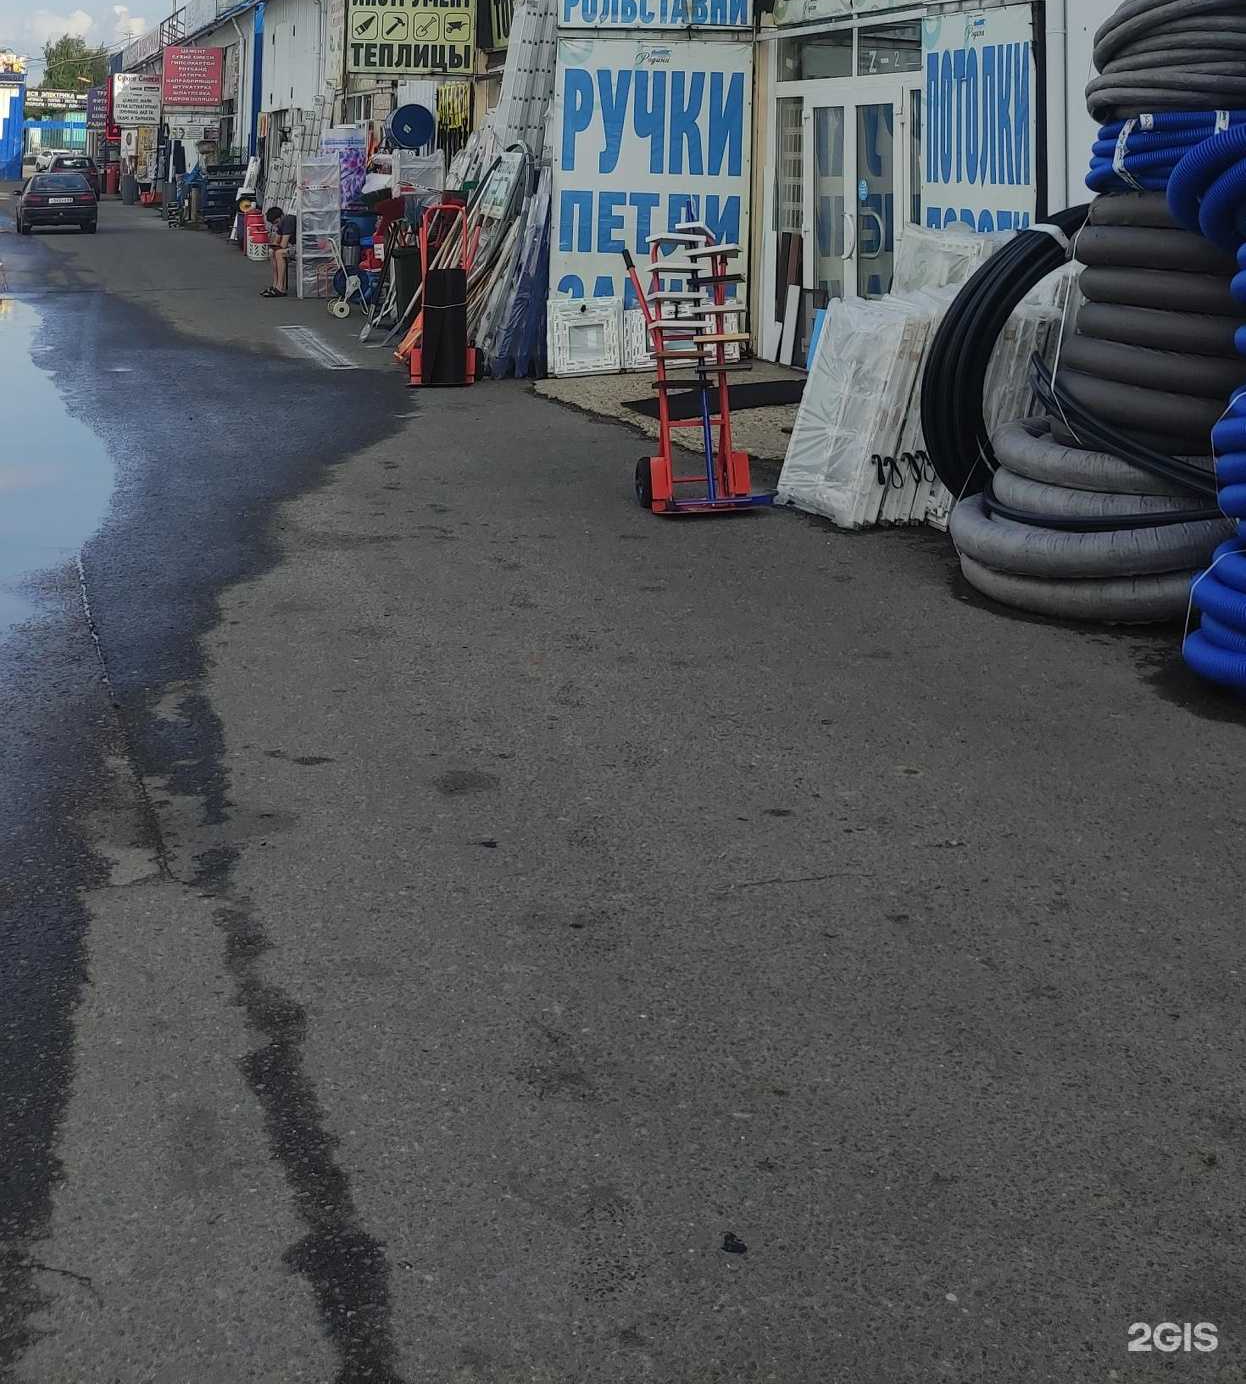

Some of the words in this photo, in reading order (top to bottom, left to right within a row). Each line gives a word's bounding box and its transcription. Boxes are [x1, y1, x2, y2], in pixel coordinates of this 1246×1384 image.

[351, 42, 471, 73] ТЕПЛИЦЫ
[562, 68, 745, 176] РУЧКИ
[926, 41, 1030, 189] ПОТОЛКИ
